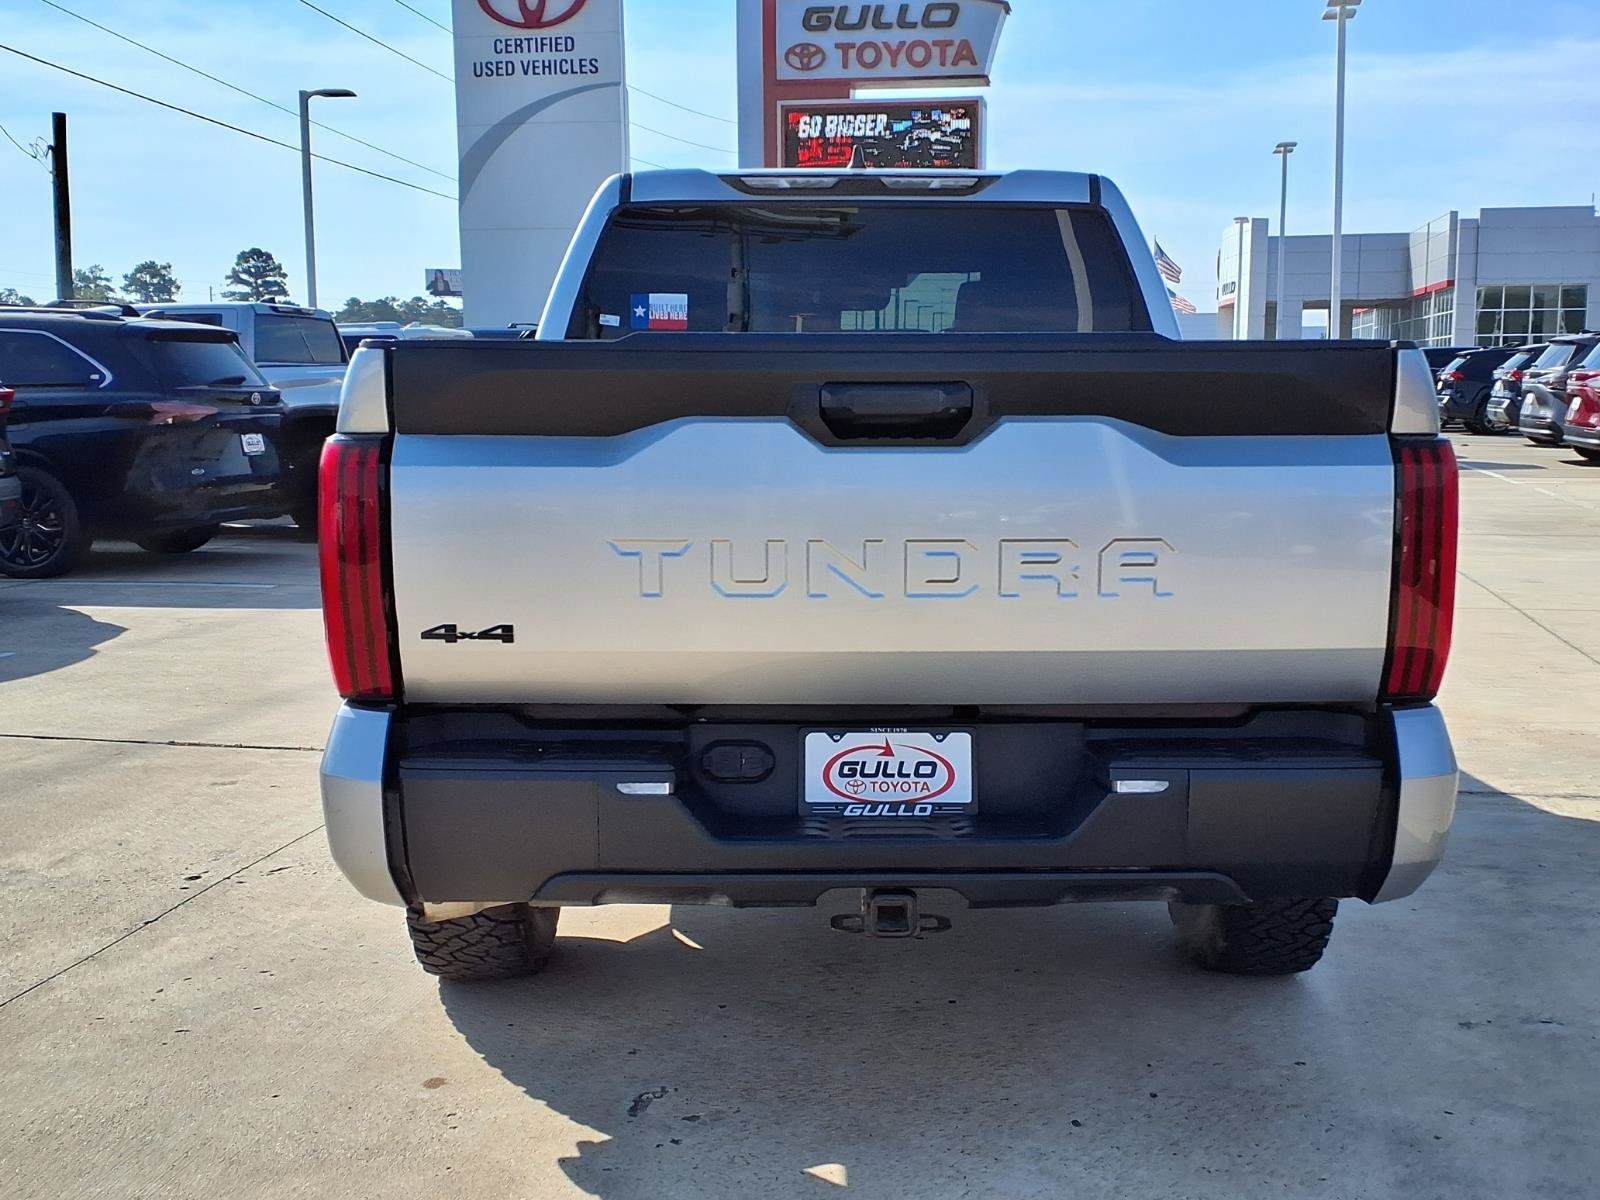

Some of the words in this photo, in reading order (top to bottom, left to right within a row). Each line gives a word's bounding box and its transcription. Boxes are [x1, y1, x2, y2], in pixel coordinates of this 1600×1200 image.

[802, 2, 960, 32] GULLO
[493, 36, 575, 54] CERTIFIED
[834, 39, 978, 69] TOYOTA
[473, 60, 516, 77] USED
[520, 58, 599, 76] VEHICLES
[649, 311, 669, 320] LIVES
[669, 311, 688, 321] HERE
[606, 538, 1177, 598] TUNDRA
[838, 761, 938, 779] GULLO
[870, 781, 931, 793] TOYOTA
[843, 804, 933, 816] GULLO
